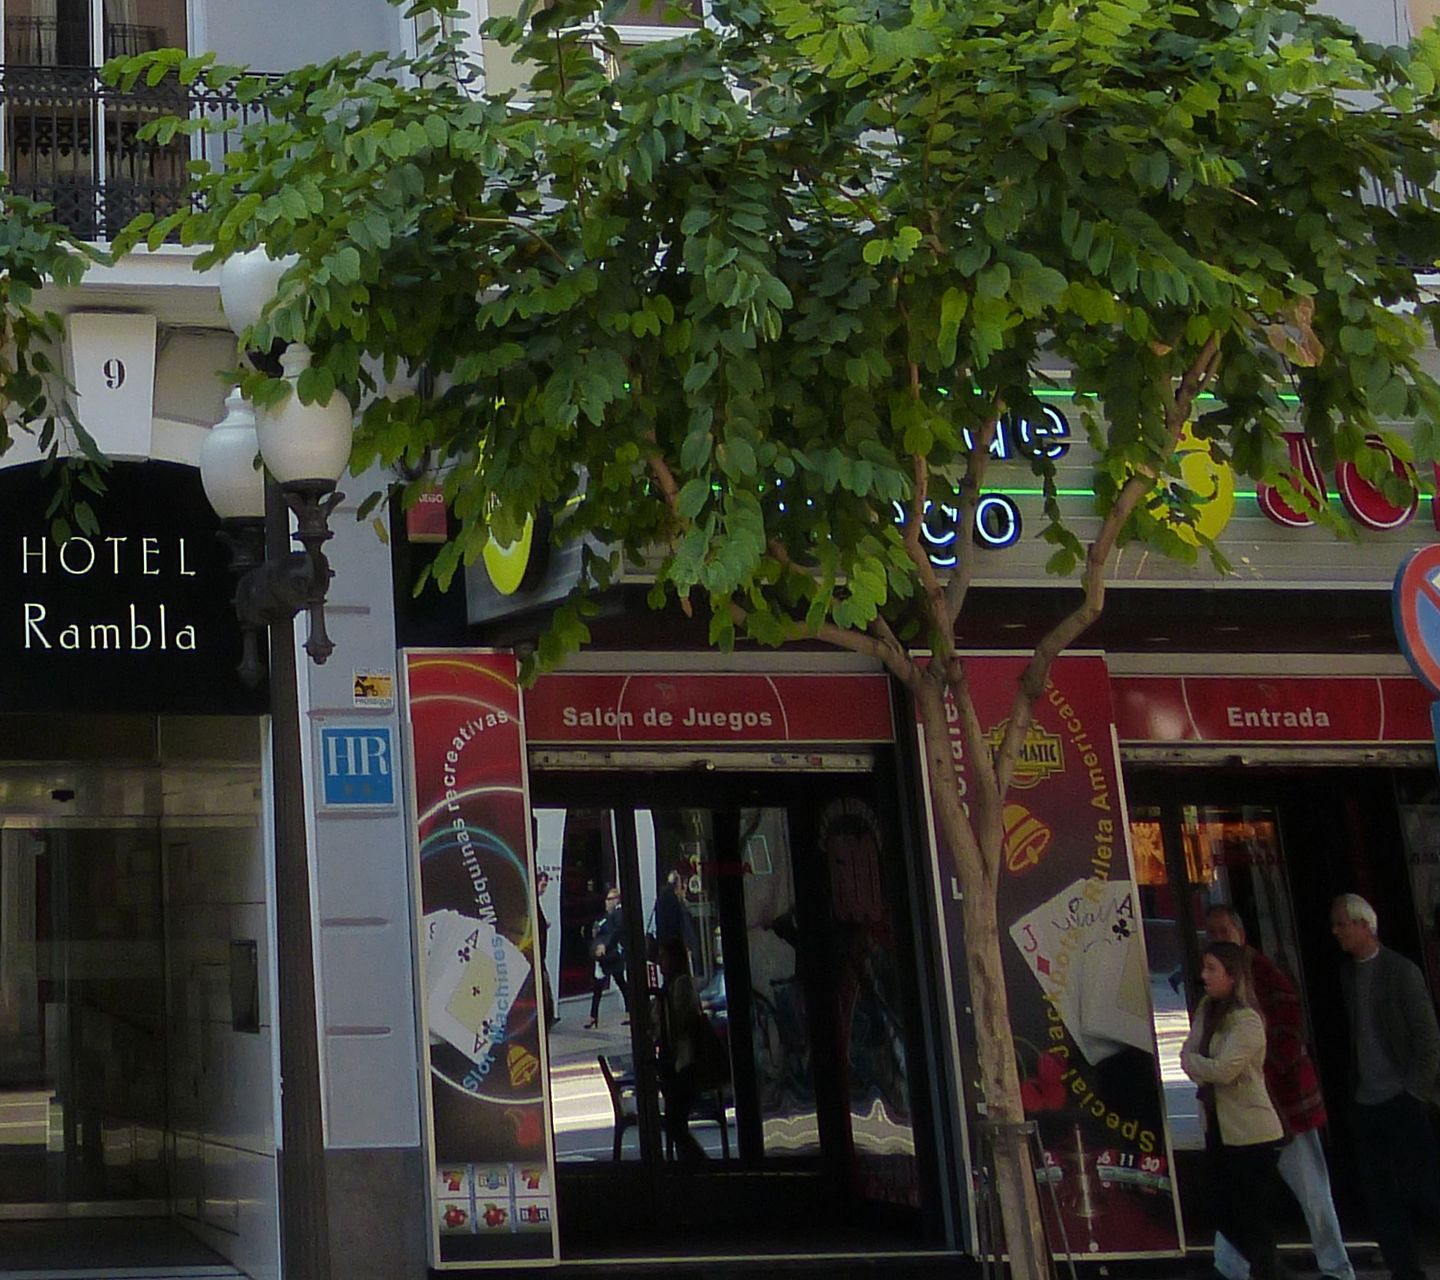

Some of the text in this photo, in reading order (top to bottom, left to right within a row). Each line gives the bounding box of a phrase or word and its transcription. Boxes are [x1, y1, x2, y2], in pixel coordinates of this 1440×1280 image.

[103, 358, 126, 389] 9
[22, 536, 196, 577] HOTEL
[23, 602, 197, 651] Rambla
[563, 706, 773, 731] Salón de Juegos
[1227, 706, 1330, 728] Entrada
[326, 736, 389, 776] HR
[443, 710, 509, 925] Máquinas recreativas
[1116, 893, 1134, 919] A
[1023, 924, 1038, 952] J
[463, 936, 511, 1093] Slot Machines
[1042, 928, 1157, 1154] Special Jackpots
[1141, 1156, 1160, 1171] 30
